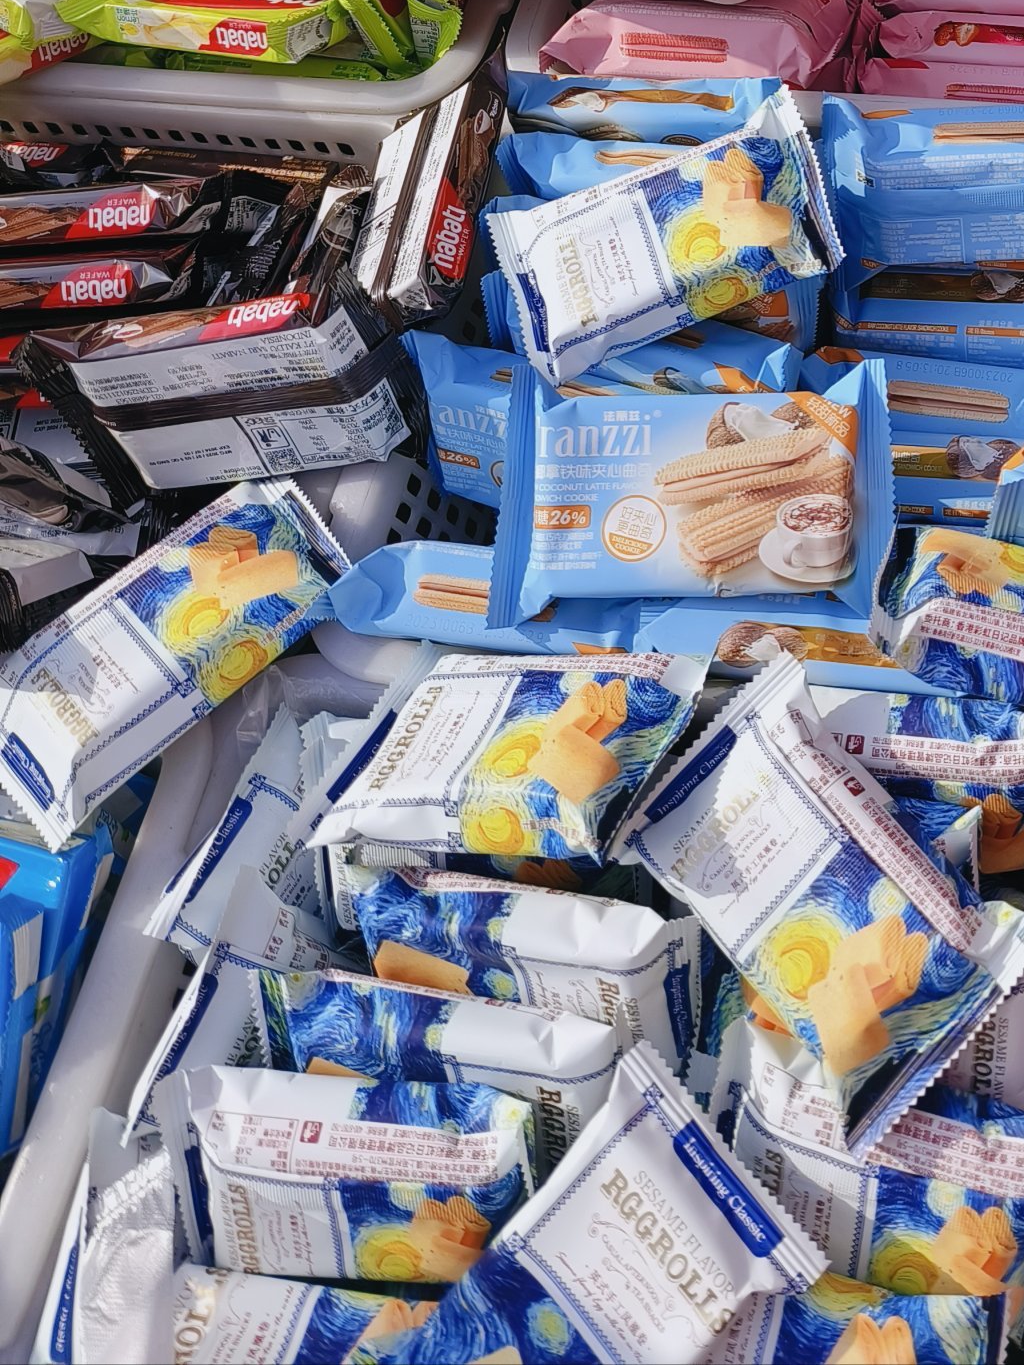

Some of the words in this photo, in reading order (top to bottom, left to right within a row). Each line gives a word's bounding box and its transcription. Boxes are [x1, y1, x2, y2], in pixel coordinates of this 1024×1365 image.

[214, 28, 268, 50] nabati
[88, 203, 151, 232] nabati
[106, 198, 137, 206] WAFER
[432, 203, 468, 269] nabati
[456, 228, 470, 259] WAFER
[61, 276, 126, 304] nabati
[79, 271, 111, 280] WAFER
[538, 414, 652, 458] ranzzi
[616, 519, 655, 539] 更曲奇
[621, 505, 658, 524] 好夹心
[656, 773, 702, 815] Inspiring
[699, 741, 733, 776] Classic
[211, 807, 244, 848] Classic
[682, 1137, 729, 1200] Inspiring
[727, 1194, 767, 1244] Classic
[600, 1167, 736, 1334] RGGROLLS
[632, 1170, 689, 1235] SESAME
[682, 1233, 736, 1300] FLAVOR
